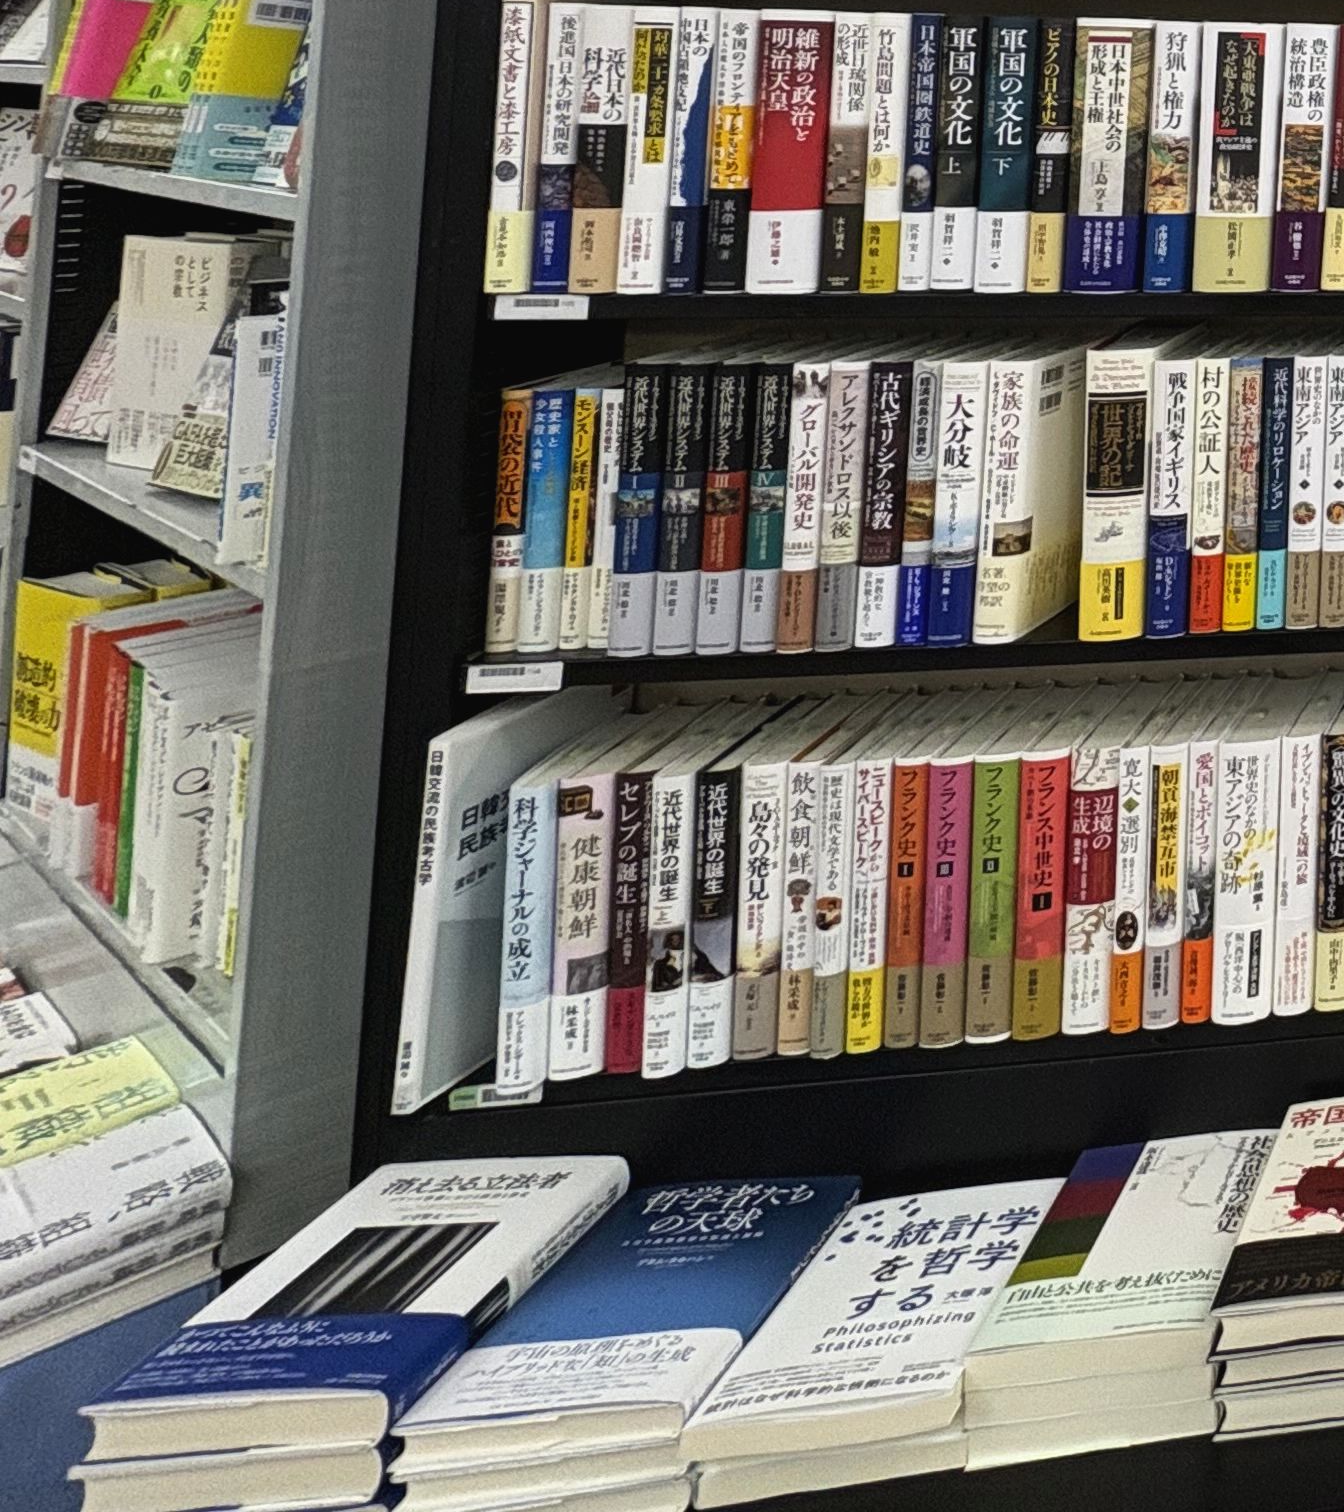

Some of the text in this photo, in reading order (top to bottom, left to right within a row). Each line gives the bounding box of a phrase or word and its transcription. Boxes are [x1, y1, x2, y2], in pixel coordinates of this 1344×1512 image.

[600, 47, 626, 122] 近代日本の
[767, 27, 793, 112] 明治天皇
[789, 27, 821, 143] 維新の政治と
[872, 27, 897, 152] 竹島問題とは何か
[943, 26, 978, 147] 軍国の文化
[993, 27, 1029, 147] 軍国の文化
[1086, 44, 1106, 124] 形成と王権
[1104, 44, 1130, 155] 日本中世社会の
[1161, 32, 1188, 131] 狩猟と権力
[1306, 39, 1326, 122] 豊臣政権の
[792, 404, 822, 531] グローバル開発史
[828, 374, 860, 539] アレクサンドロス以後
[872, 371, 900, 531] 古代ギリシアの宗教
[944, 394, 976, 470] 大分岐
[996, 372, 1024, 472] 家族の命運
[1163, 371, 1189, 509] 戦争国家イギリス
[1198, 369, 1223, 474] 村の公証人
[615, 782, 639, 905] セレブの誕生
[658, 789, 685, 902] 近代世界の誕生
[745, 803, 772, 902] 島々の発見
[788, 771, 815, 876] 飲食朝鮮
[981, 766, 1004, 855] フランク史
[1031, 766, 1056, 888] フランス中世史
[1089, 794, 1113, 849] 辺境の
[1220, 760, 1244, 896] 東アジアの奇跡
[503, 796, 538, 984] 科学ジャーナルの成立
[568, 837, 602, 942] 健康朝鮮
[642, 1183, 816, 1214] 哲学者たち
[648, 1207, 761, 1232] の天球
[888, 1204, 1041, 1249] 統計学
[1214, 1136, 1272, 1234] 社会思想の歴史
[849, 1286, 936, 1314] する
[872, 1241, 1020, 1282] を哲学
[810, 1331, 912, 1355] Statistics
[822, 1310, 975, 1339] Philosophizing
